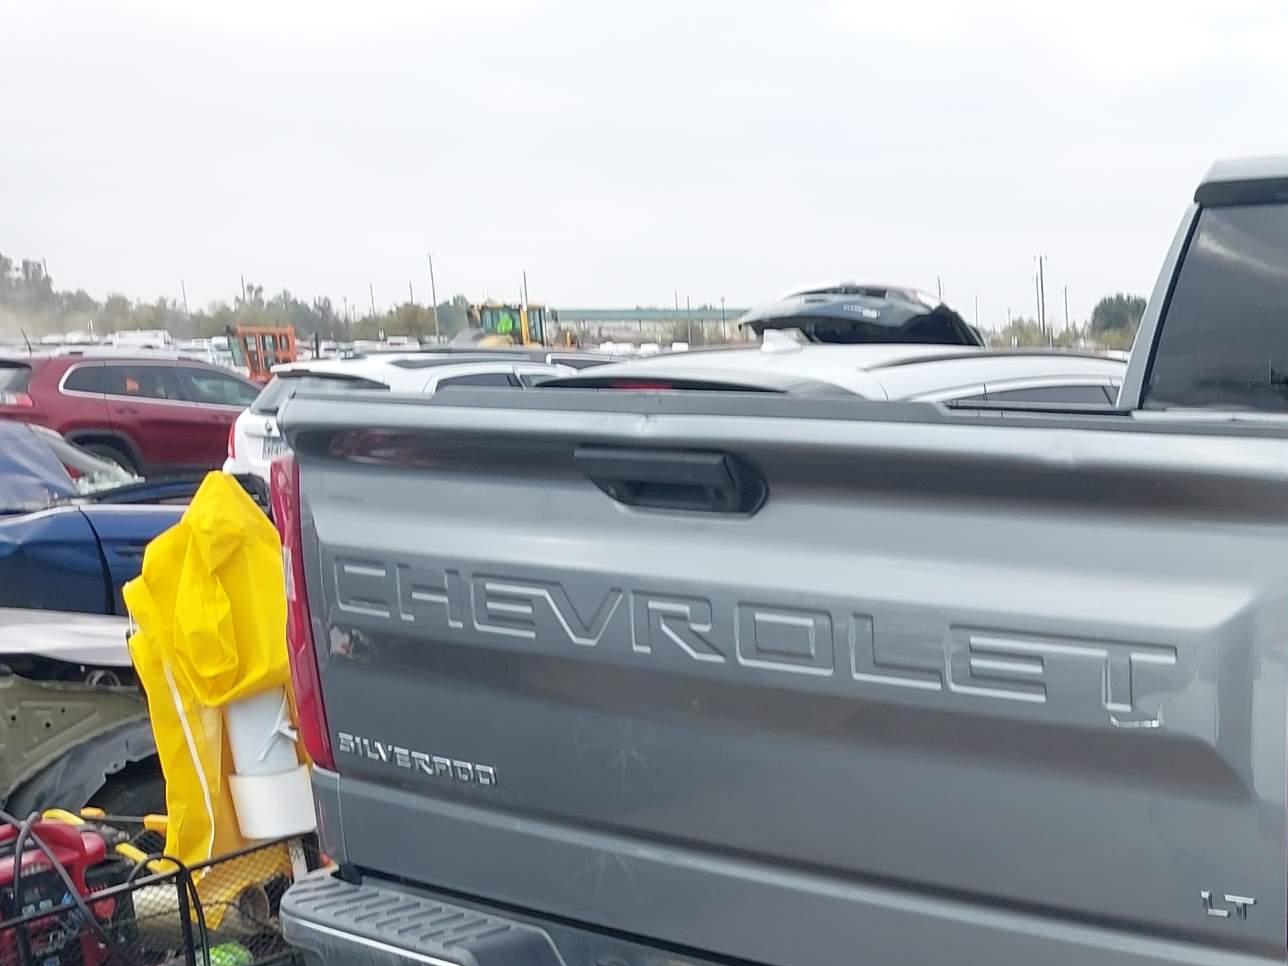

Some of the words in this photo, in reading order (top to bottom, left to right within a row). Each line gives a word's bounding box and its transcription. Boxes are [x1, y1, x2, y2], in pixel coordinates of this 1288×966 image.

[334, 555, 1178, 713] CHEVROLET
[338, 731, 497, 786] SILVERADO
[1200, 889, 1256, 920] LT
